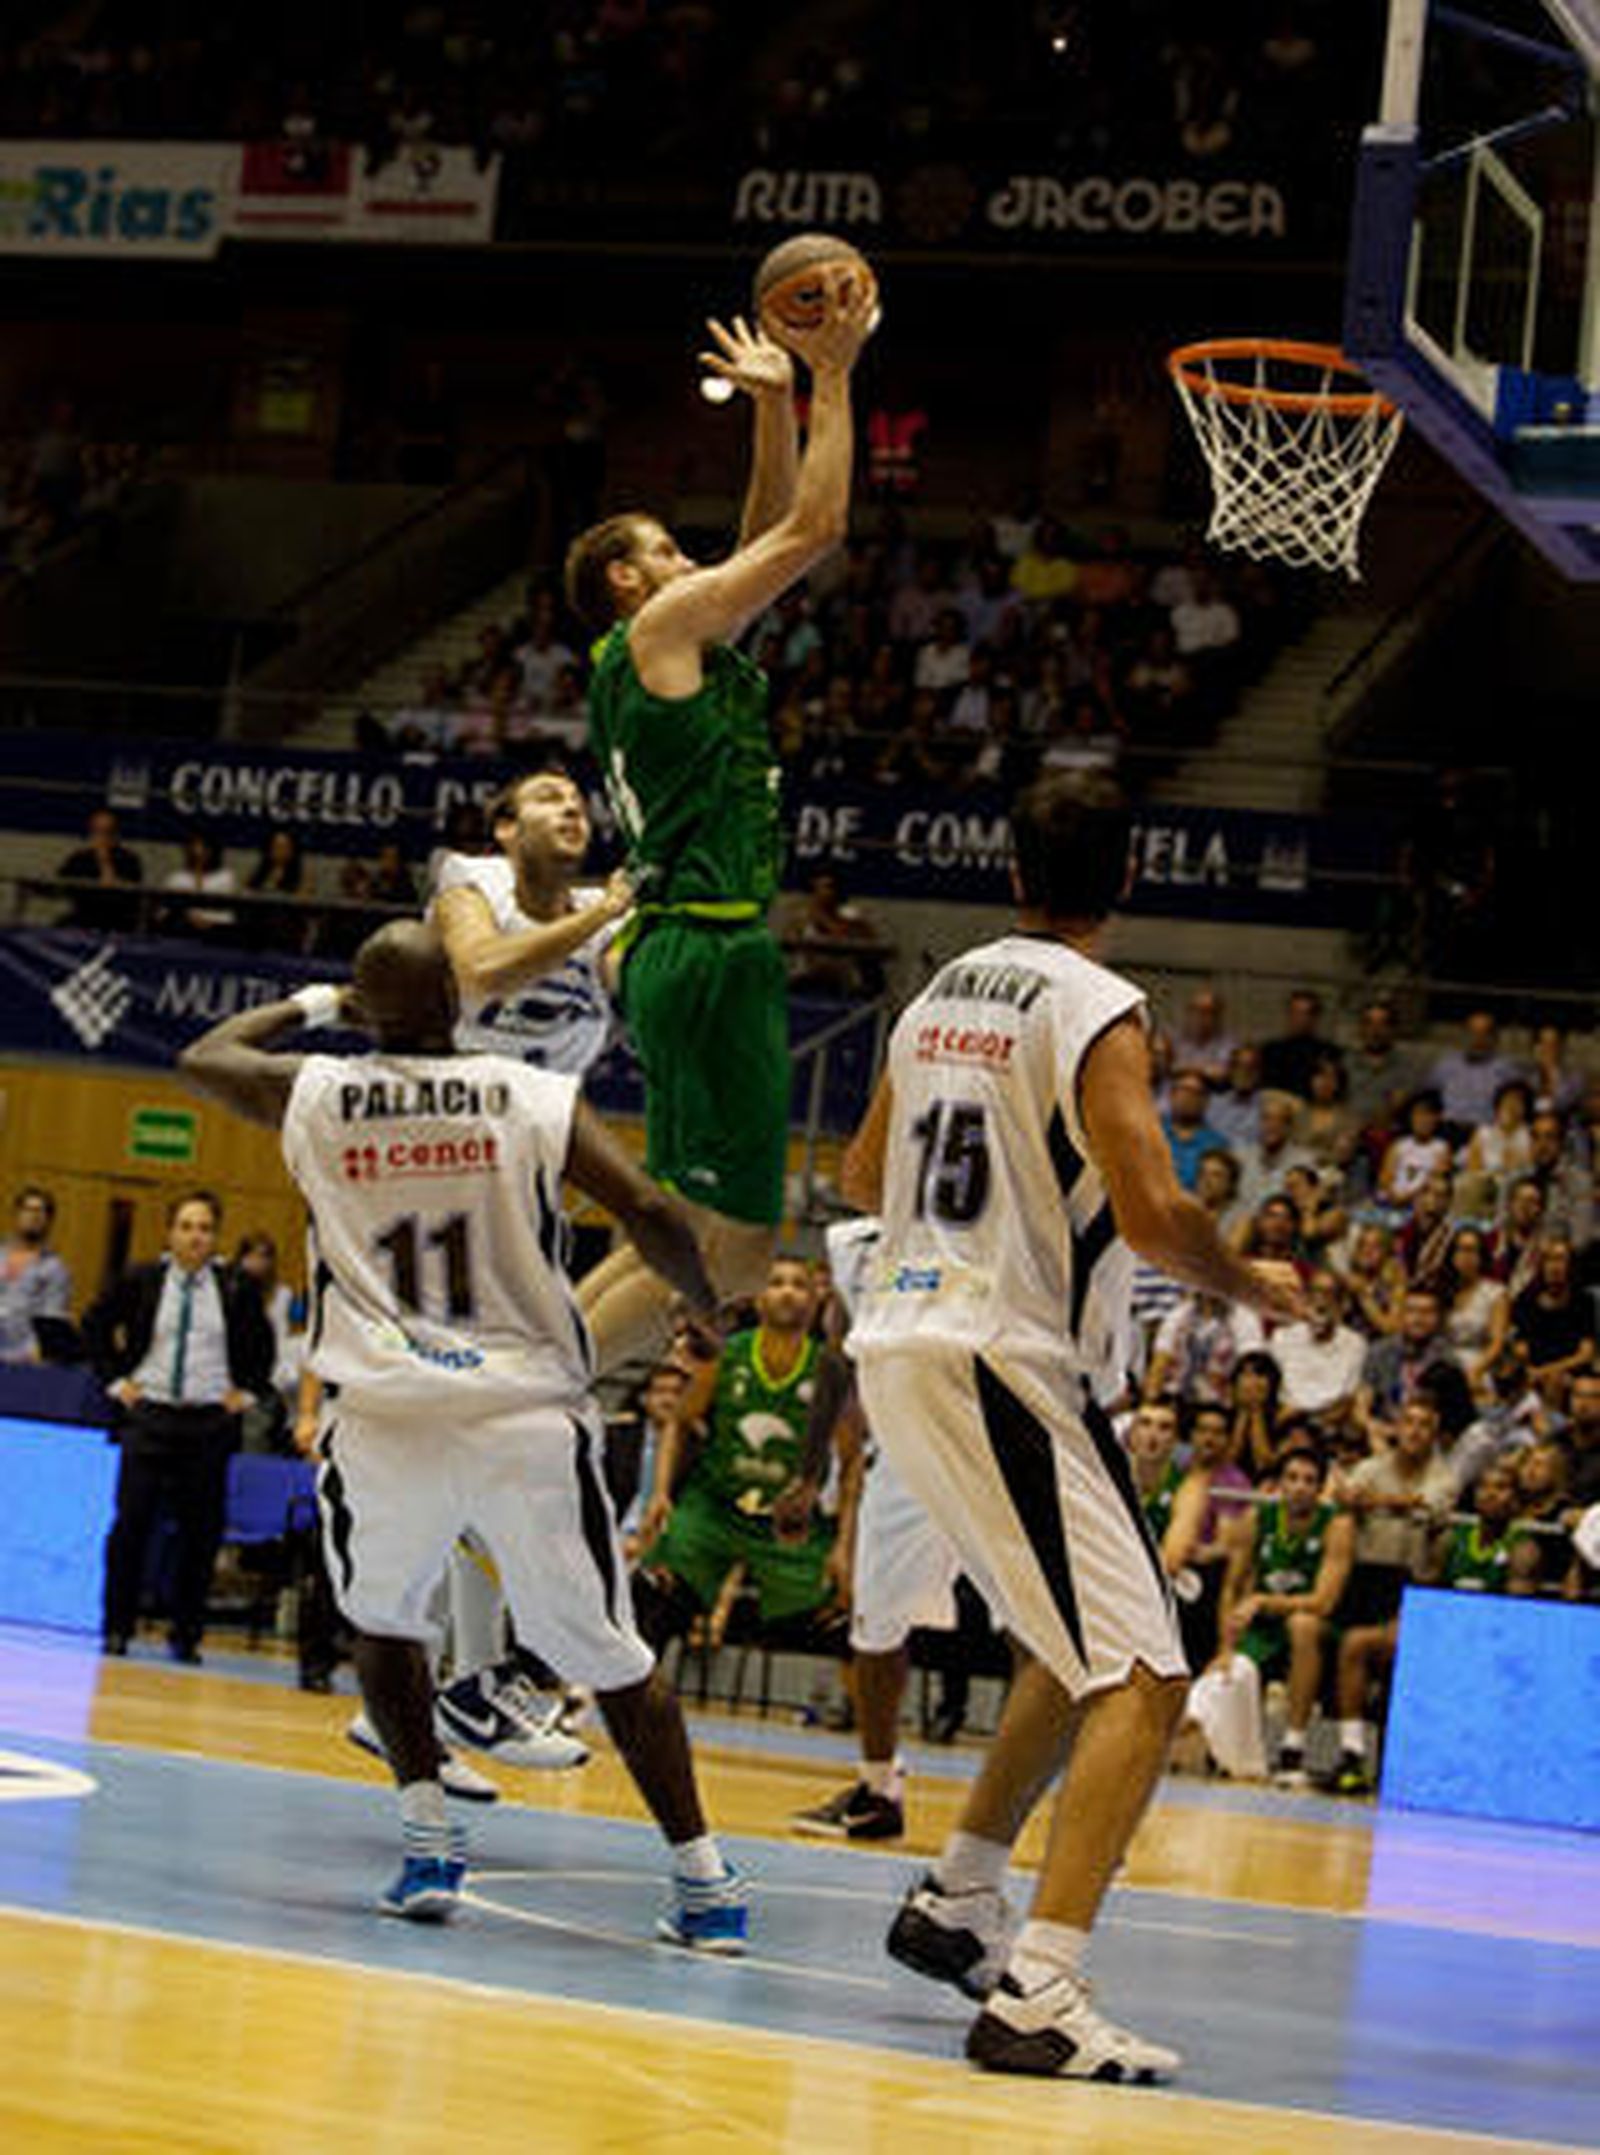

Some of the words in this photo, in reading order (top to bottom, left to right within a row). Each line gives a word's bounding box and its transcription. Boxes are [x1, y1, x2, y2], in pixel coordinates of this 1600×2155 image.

[734, 170, 881, 222] RUTA
[987, 177, 1285, 237] JACOBEA
[168, 761, 403, 827] CONCELLO
[795, 805, 863, 863] DE
[341, 1079, 509, 1122] PALACIO
[913, 1097, 991, 1229] 15
[375, 1212, 476, 1320] 11
